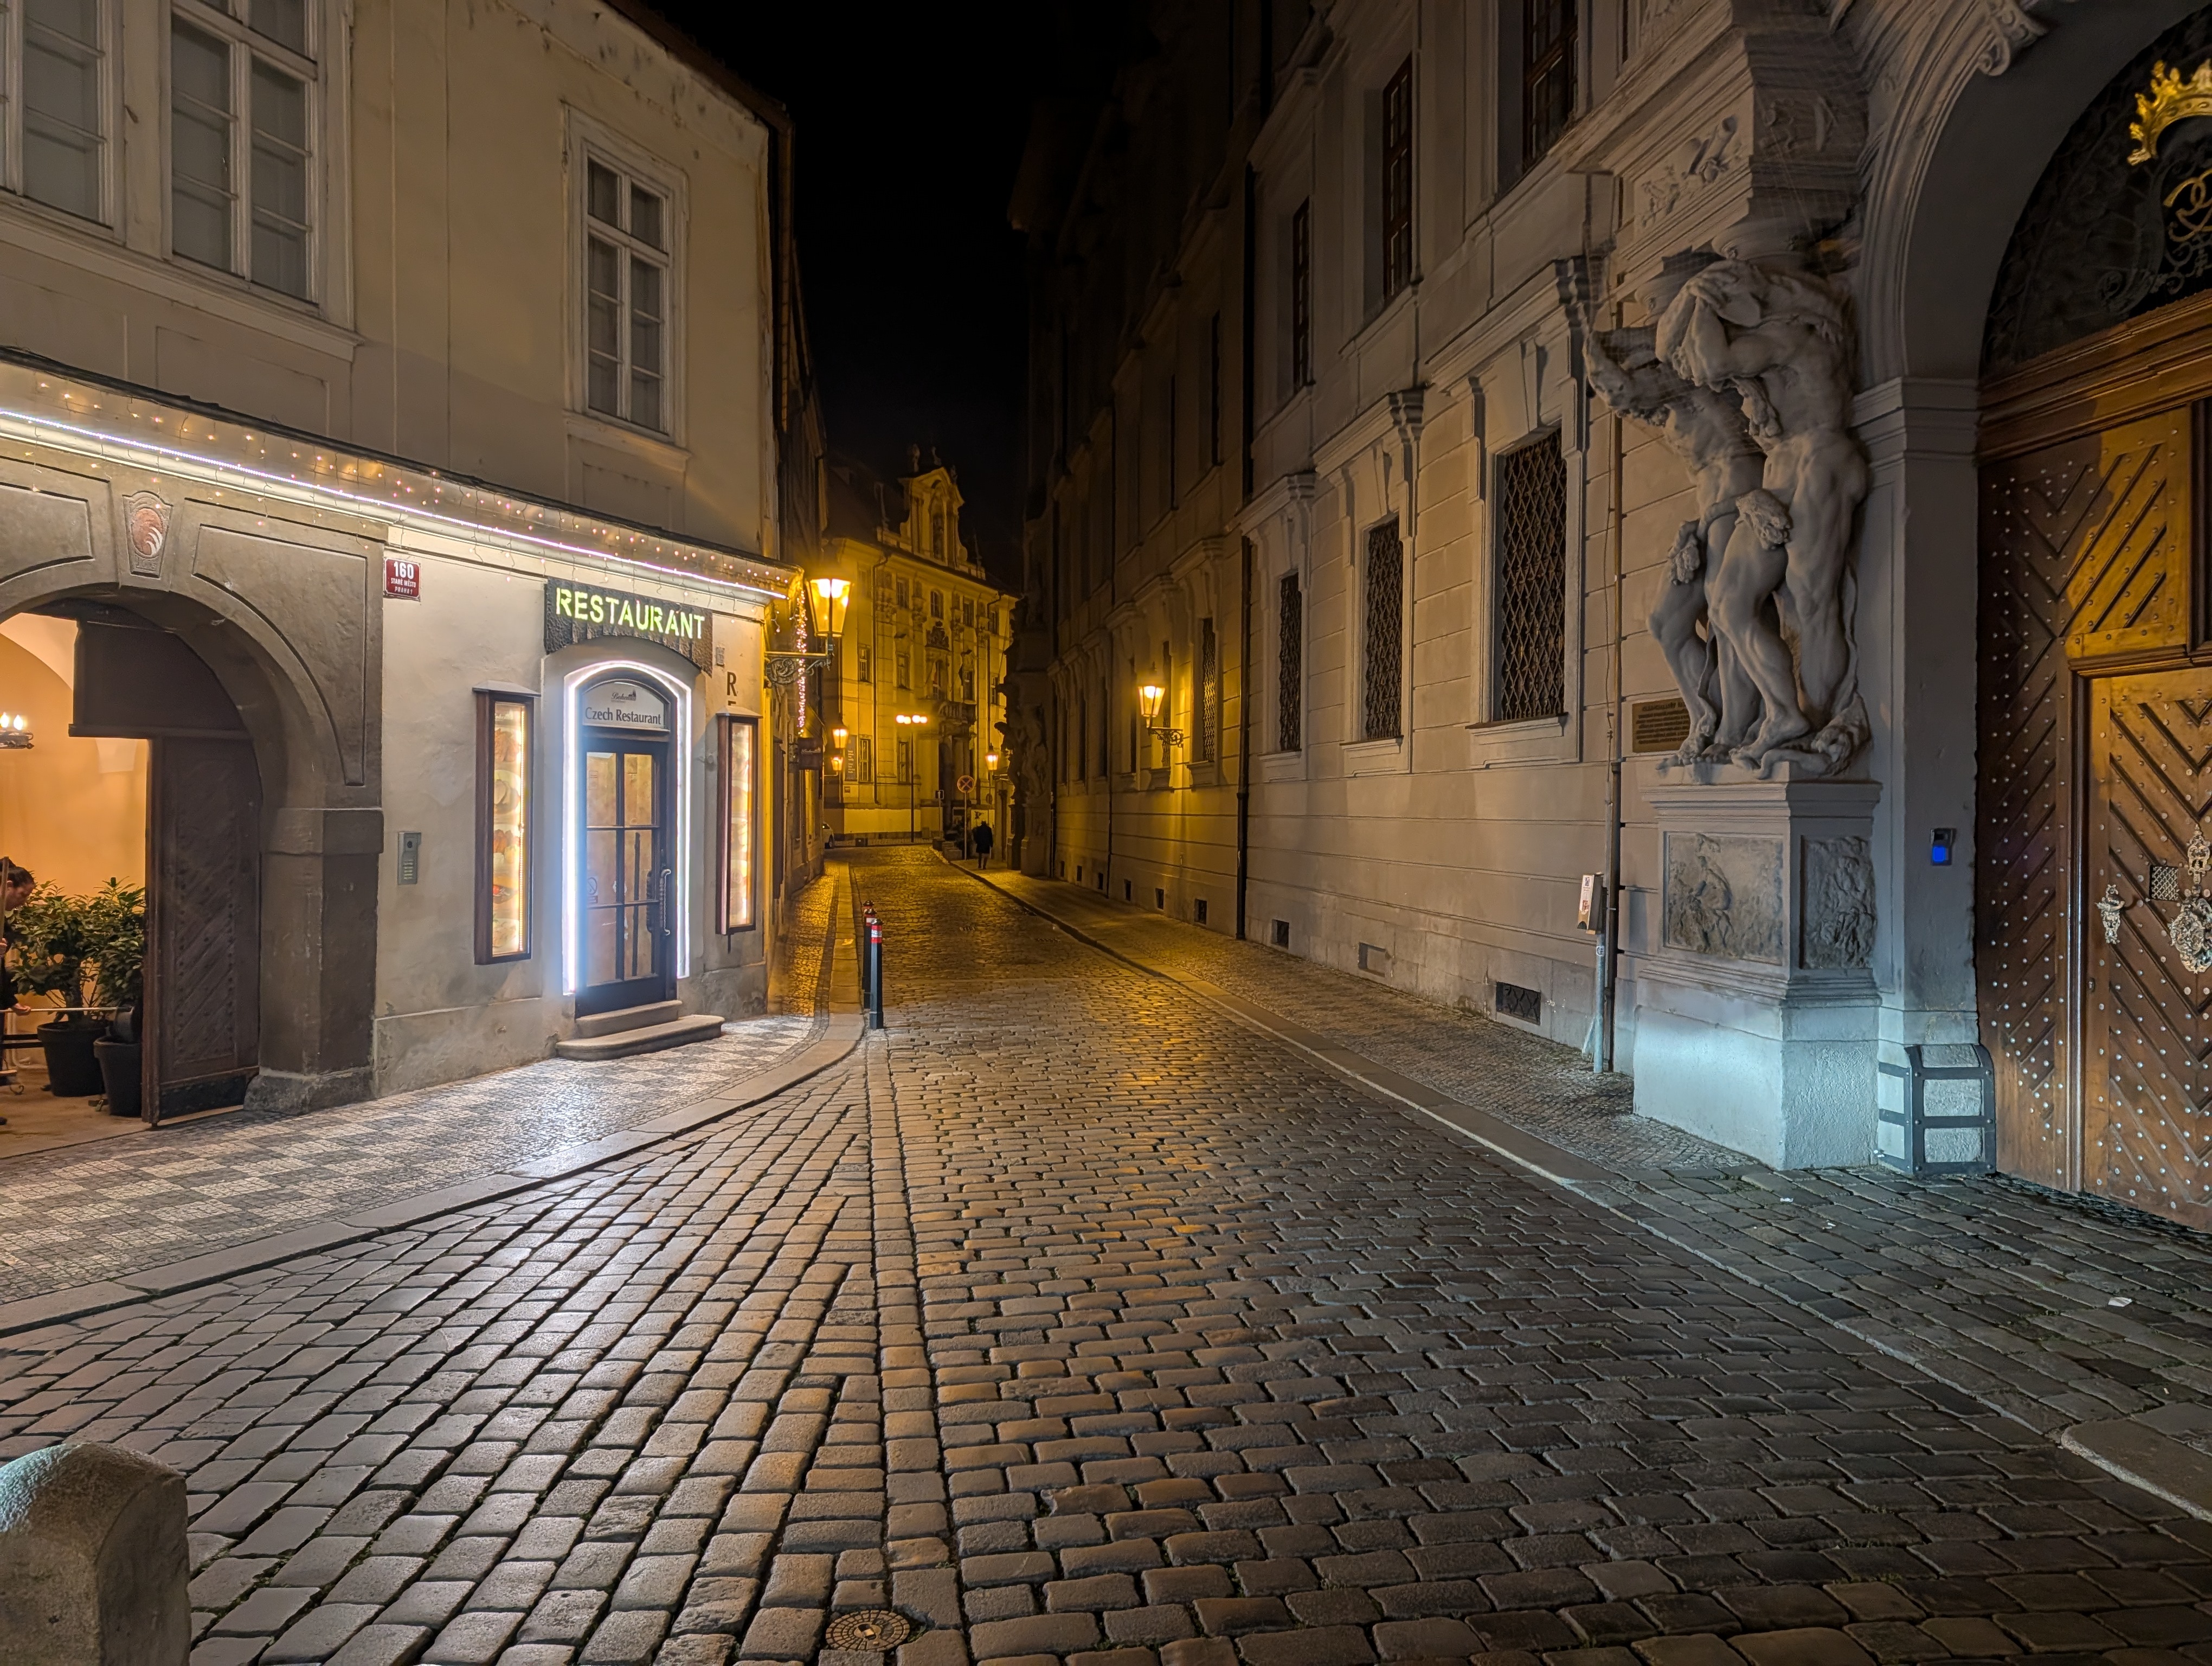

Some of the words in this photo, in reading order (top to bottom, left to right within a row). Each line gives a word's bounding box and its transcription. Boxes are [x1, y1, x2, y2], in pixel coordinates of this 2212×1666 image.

[394, 561, 414, 579] 160
[391, 578, 403, 586] STARÉ
[404, 579, 416, 587] MĚSTO
[556, 587, 705, 639] RESTAURANT
[585, 707, 613, 721] Czech
[616, 709, 661, 725] Restaurant
